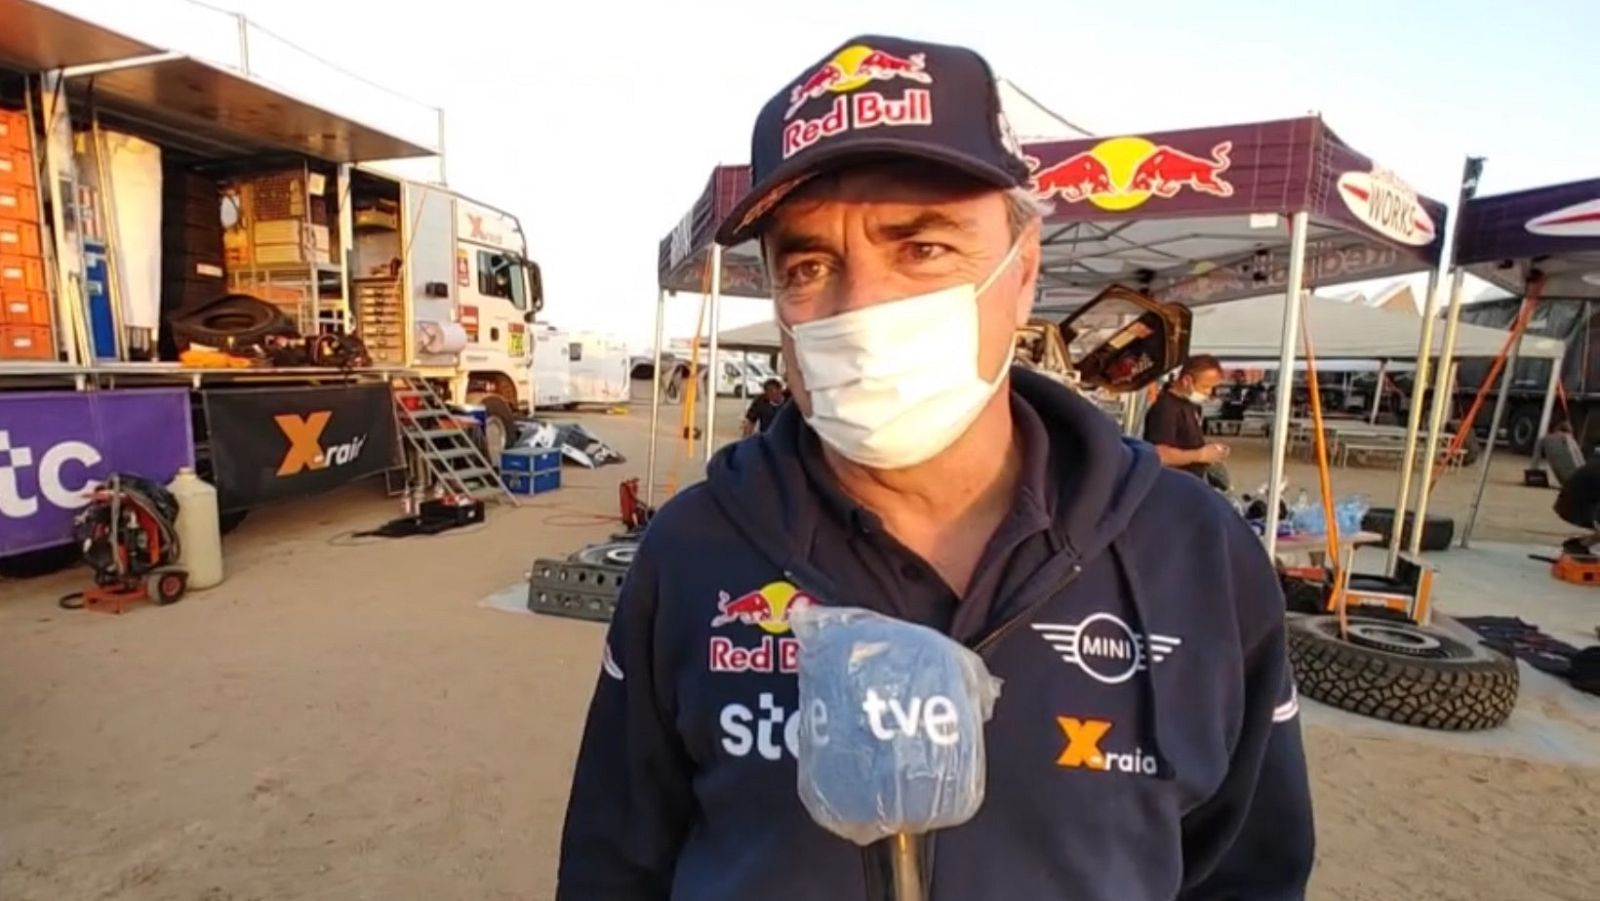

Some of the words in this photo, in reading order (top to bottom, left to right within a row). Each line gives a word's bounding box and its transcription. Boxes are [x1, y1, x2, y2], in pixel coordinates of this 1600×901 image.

[783, 94, 848, 160] Red
[853, 88, 933, 129] Bull
[1367, 182, 1416, 237] WORKS
[710, 636, 774, 673] Red
[1082, 635, 1132, 660] MINI
[862, 689, 960, 746] tve
